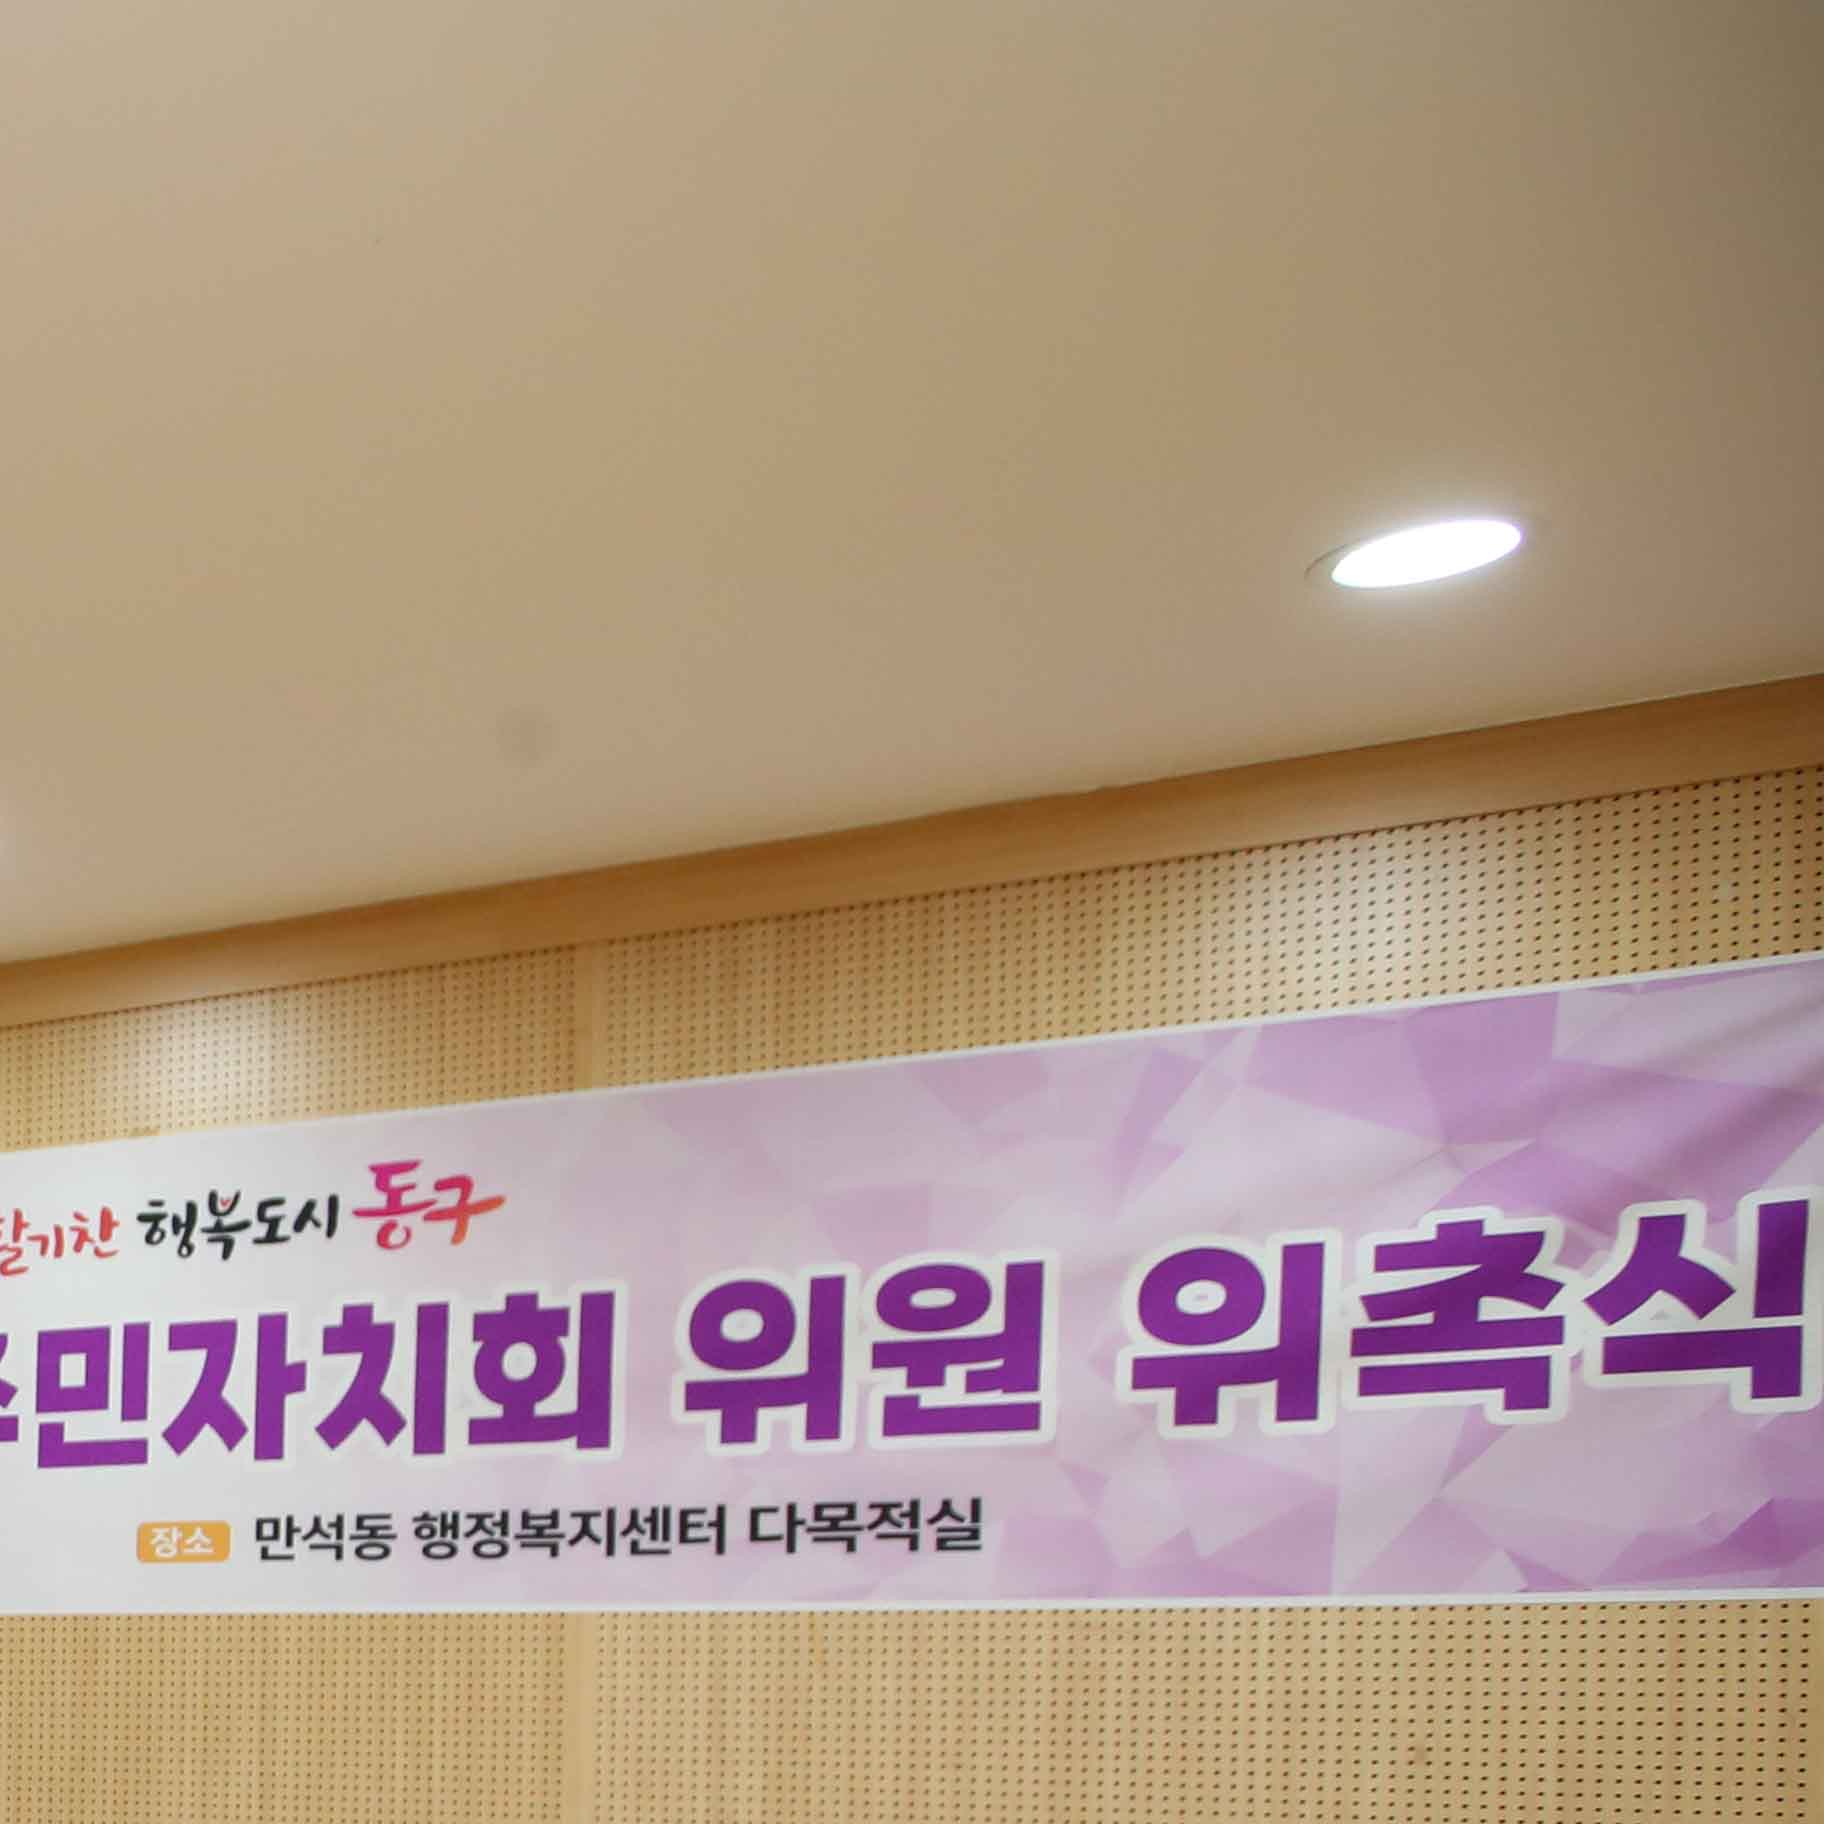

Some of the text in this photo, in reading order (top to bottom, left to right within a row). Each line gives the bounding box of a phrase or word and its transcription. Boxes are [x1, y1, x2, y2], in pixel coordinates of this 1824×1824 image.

[137, 1189, 339, 1260] 행복도시
[353, 1158, 508, 1252] 동구
[684, 1261, 1044, 1444] 위원
[1131, 1199, 1809, 1427] 위촉식
[148, 1495, 983, 1560] 장소 만석동 행정복지센터 다목적실
